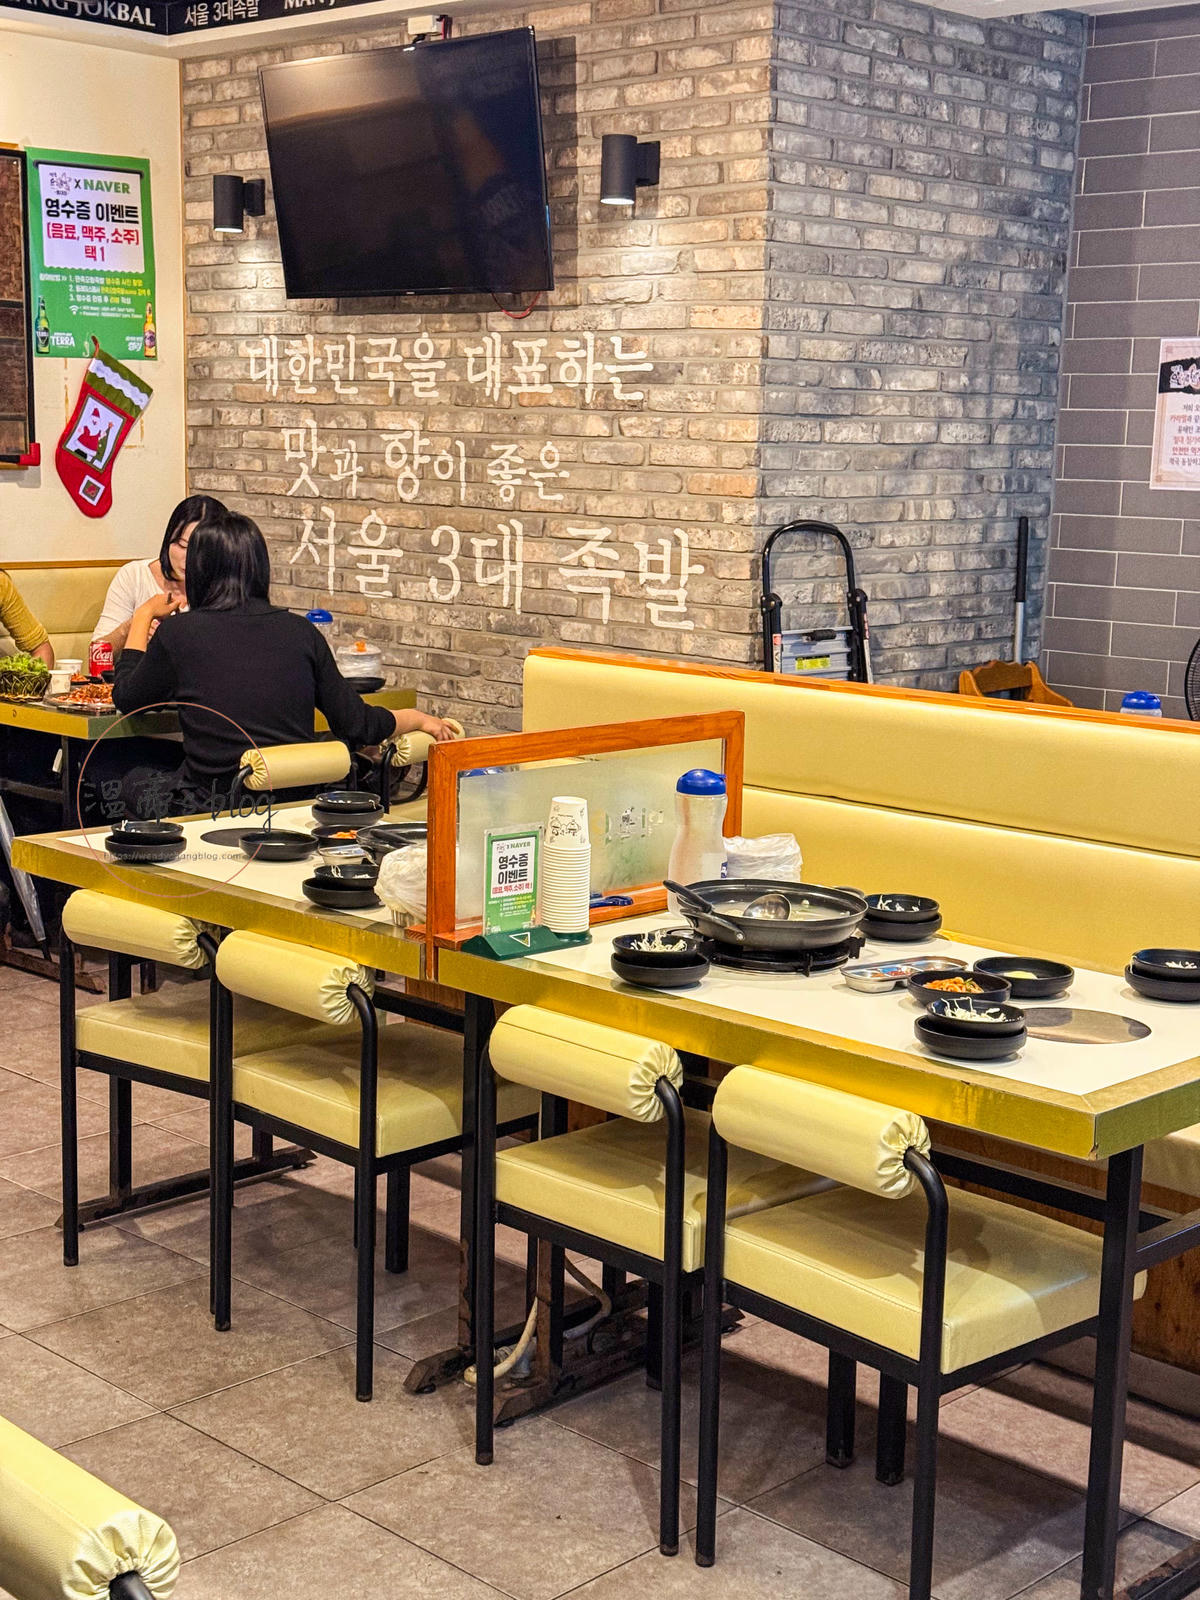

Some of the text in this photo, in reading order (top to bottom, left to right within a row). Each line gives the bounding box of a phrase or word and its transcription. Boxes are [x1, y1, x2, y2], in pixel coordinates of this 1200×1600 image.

[75, 0, 155, 27] JOKBAL
[184, 3, 209, 26] 서울
[84, 179, 130, 194] NAVER
[45, 198, 139, 224] 영수증 이벤트
[249, 331, 654, 403] 대한민국을 대표하는
[281, 418, 569, 503] 맛과 향이 좋은
[290, 506, 705, 631] 서울 3대 족발
[498, 853, 528, 870] 영수증
[497, 868, 528, 885] 이벤트
